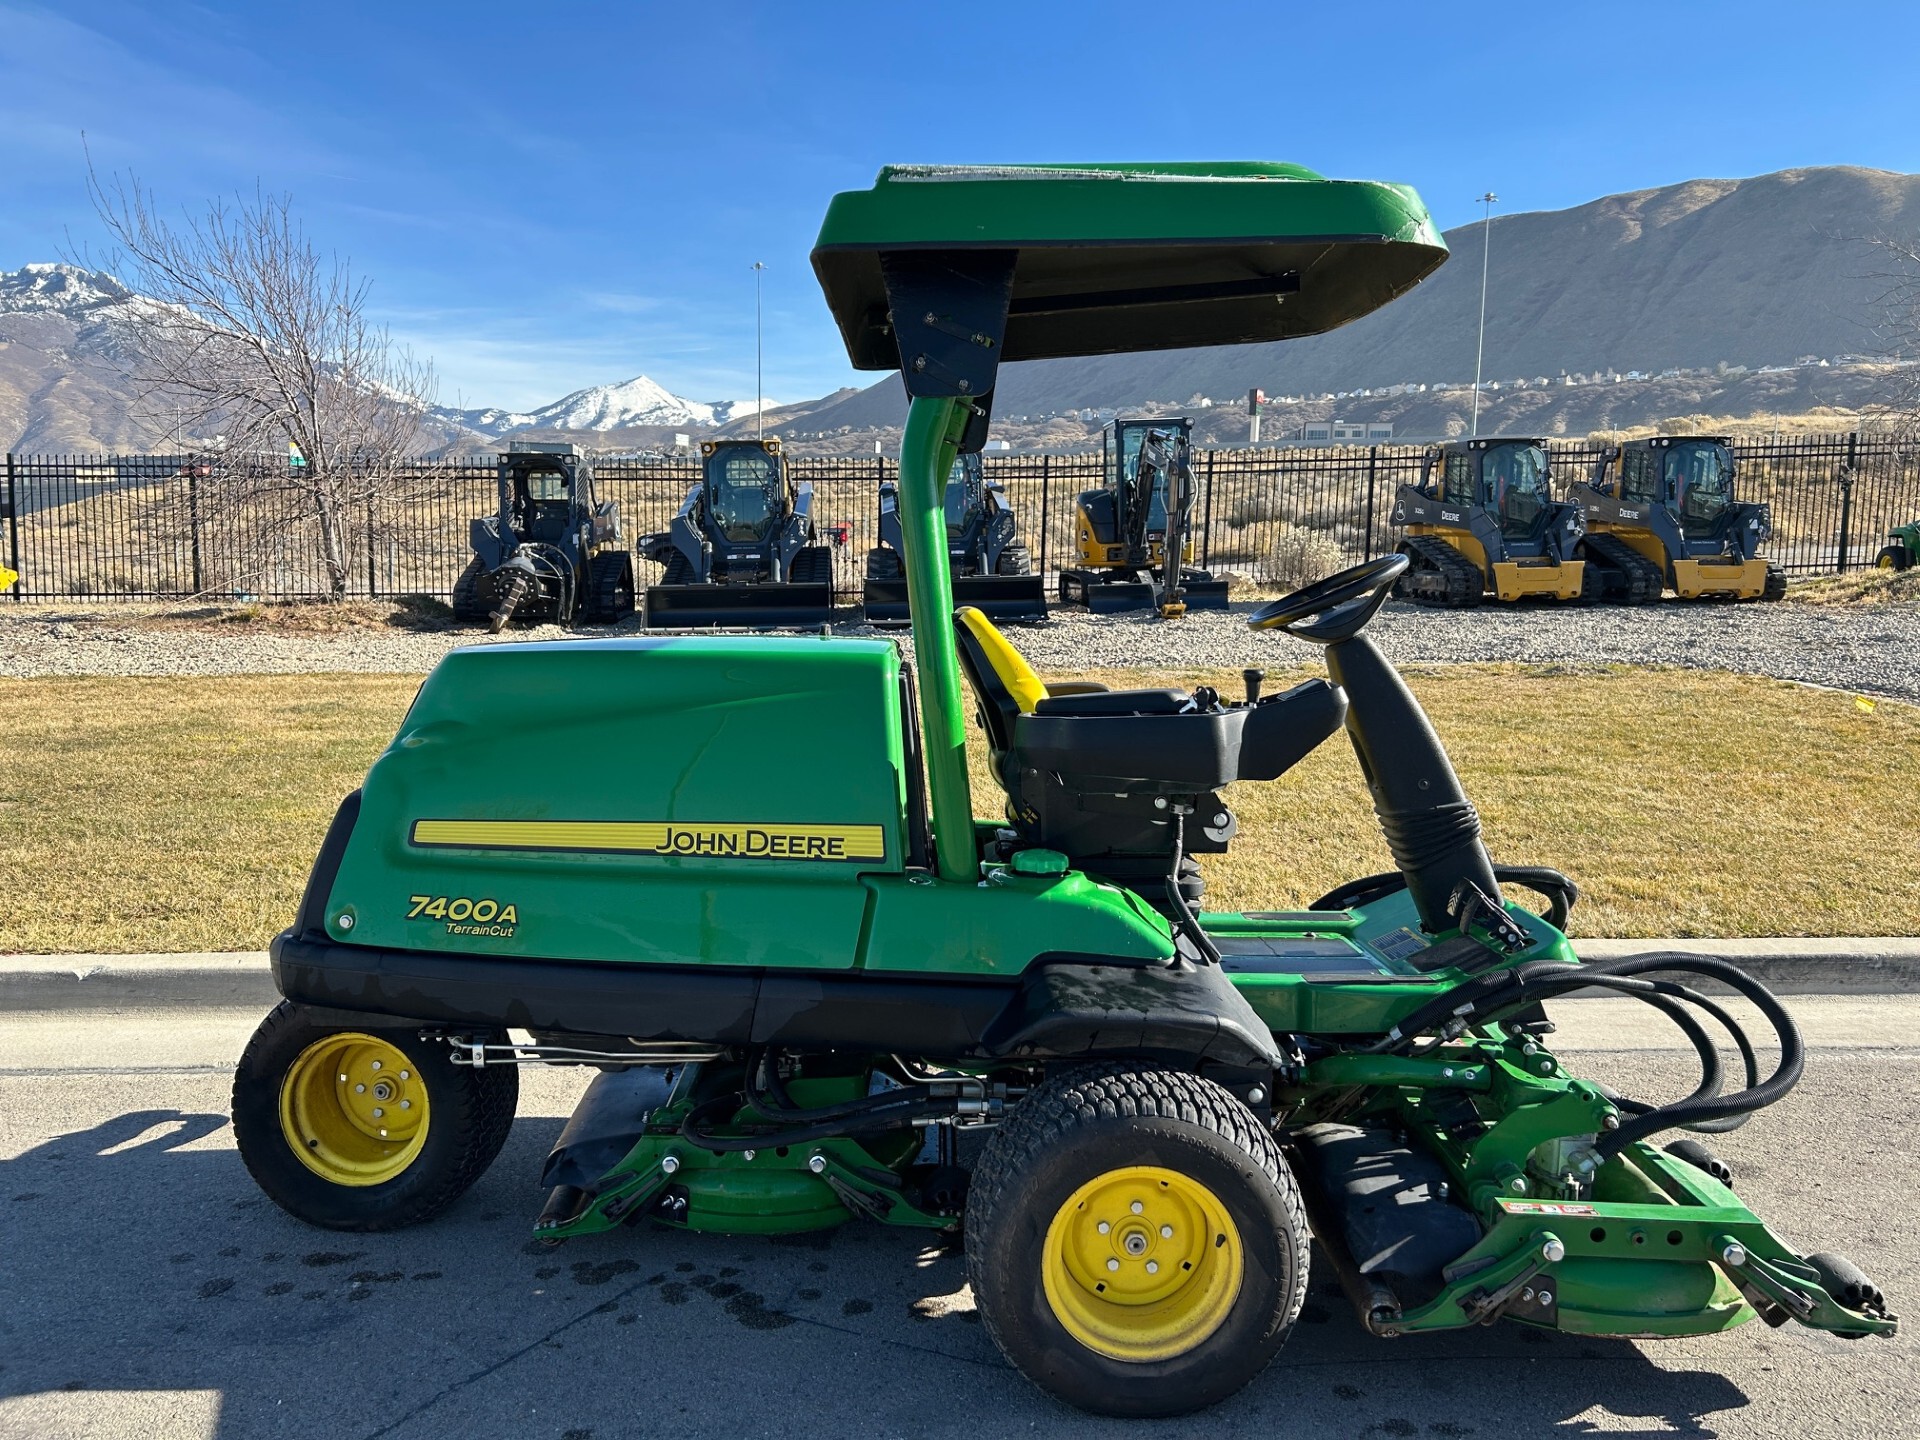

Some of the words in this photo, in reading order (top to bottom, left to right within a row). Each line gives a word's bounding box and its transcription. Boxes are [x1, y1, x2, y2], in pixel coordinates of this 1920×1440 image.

[1441, 510, 1460, 522] DEERE
[1619, 507, 1639, 520] DEERE
[656, 826, 738, 854] JOHN
[745, 828, 845, 857] DEERE
[405, 894, 517, 924] 7400A
[445, 922, 515, 937] TerrainCut
